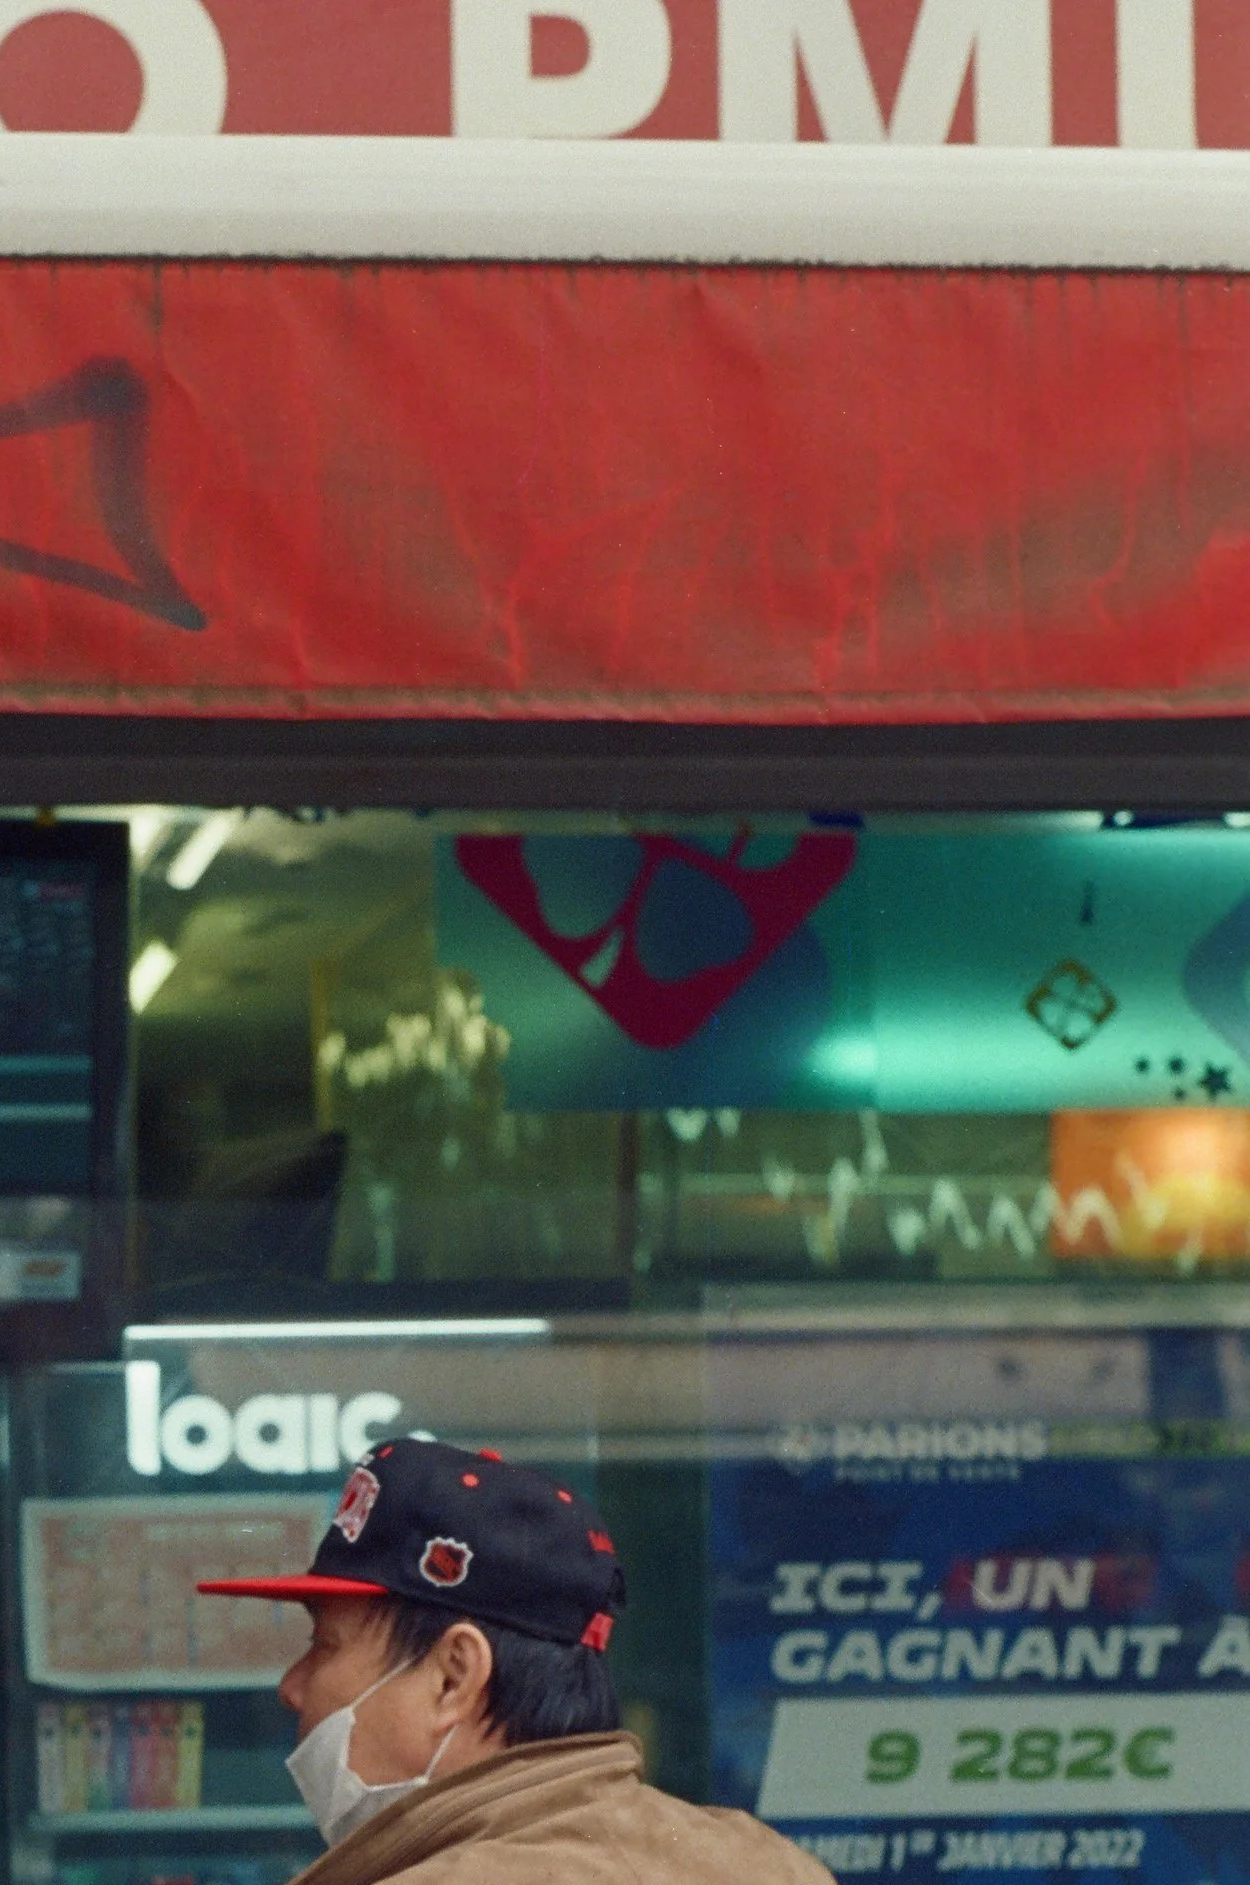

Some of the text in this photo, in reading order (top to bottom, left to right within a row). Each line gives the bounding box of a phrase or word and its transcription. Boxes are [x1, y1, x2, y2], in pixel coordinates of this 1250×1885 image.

[833, 1422, 1047, 1461] PARIONS
[768, 1556, 1097, 1621] ICI, UN
[769, 1625, 1181, 1684] GAGNANT
[864, 1729, 922, 1785] 9
[935, 1829, 1067, 1872] JANVIER
[1068, 1827, 1146, 1870] 2022
